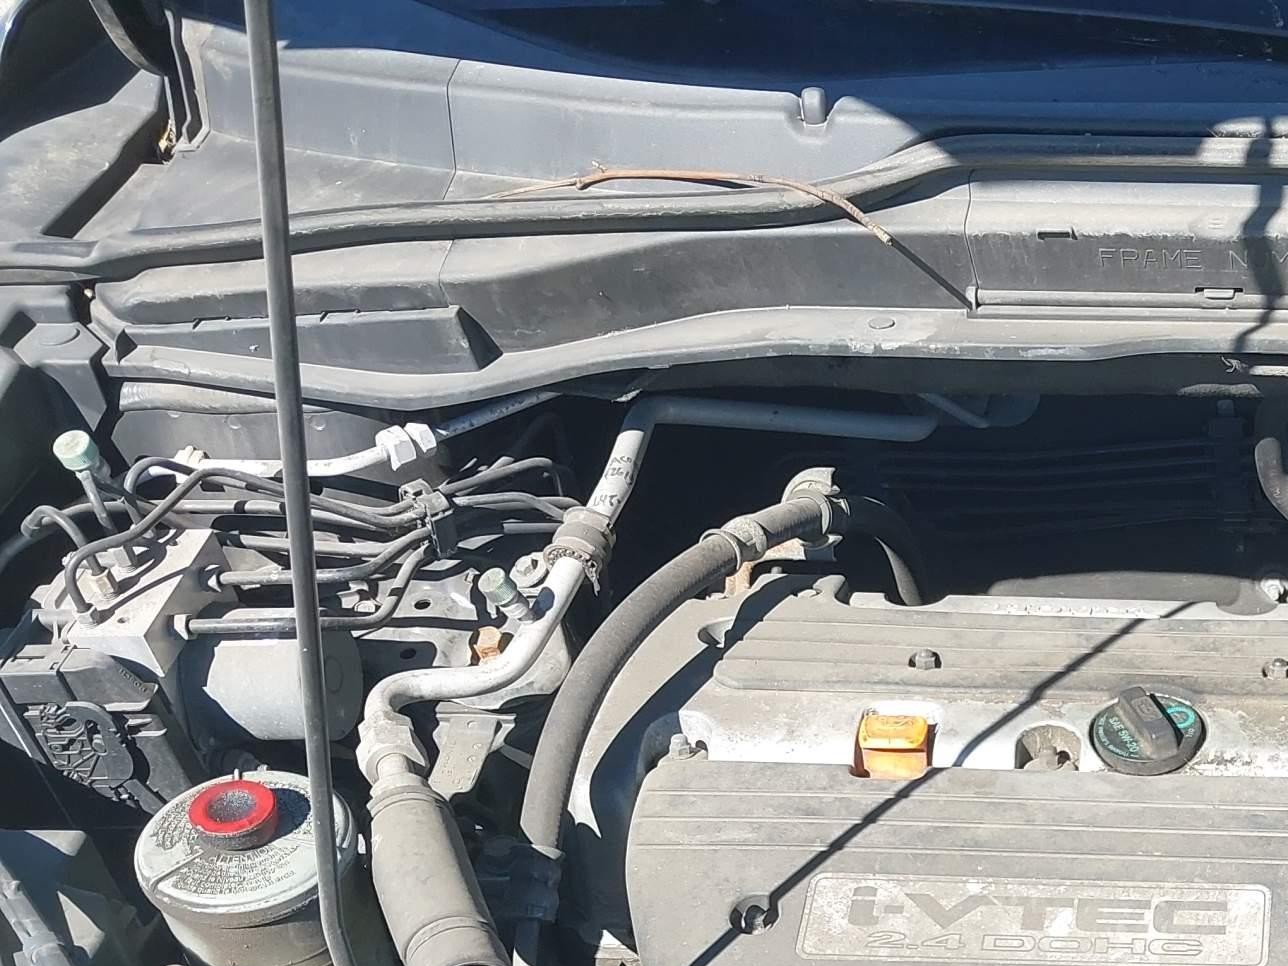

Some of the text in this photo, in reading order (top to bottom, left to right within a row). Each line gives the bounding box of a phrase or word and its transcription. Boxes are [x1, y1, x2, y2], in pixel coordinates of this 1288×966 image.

[1098, 247, 1202, 269] FRAME
[847, 885, 1227, 936] i-VTEC
[865, 930, 1204, 957] 2.4 DOHC
